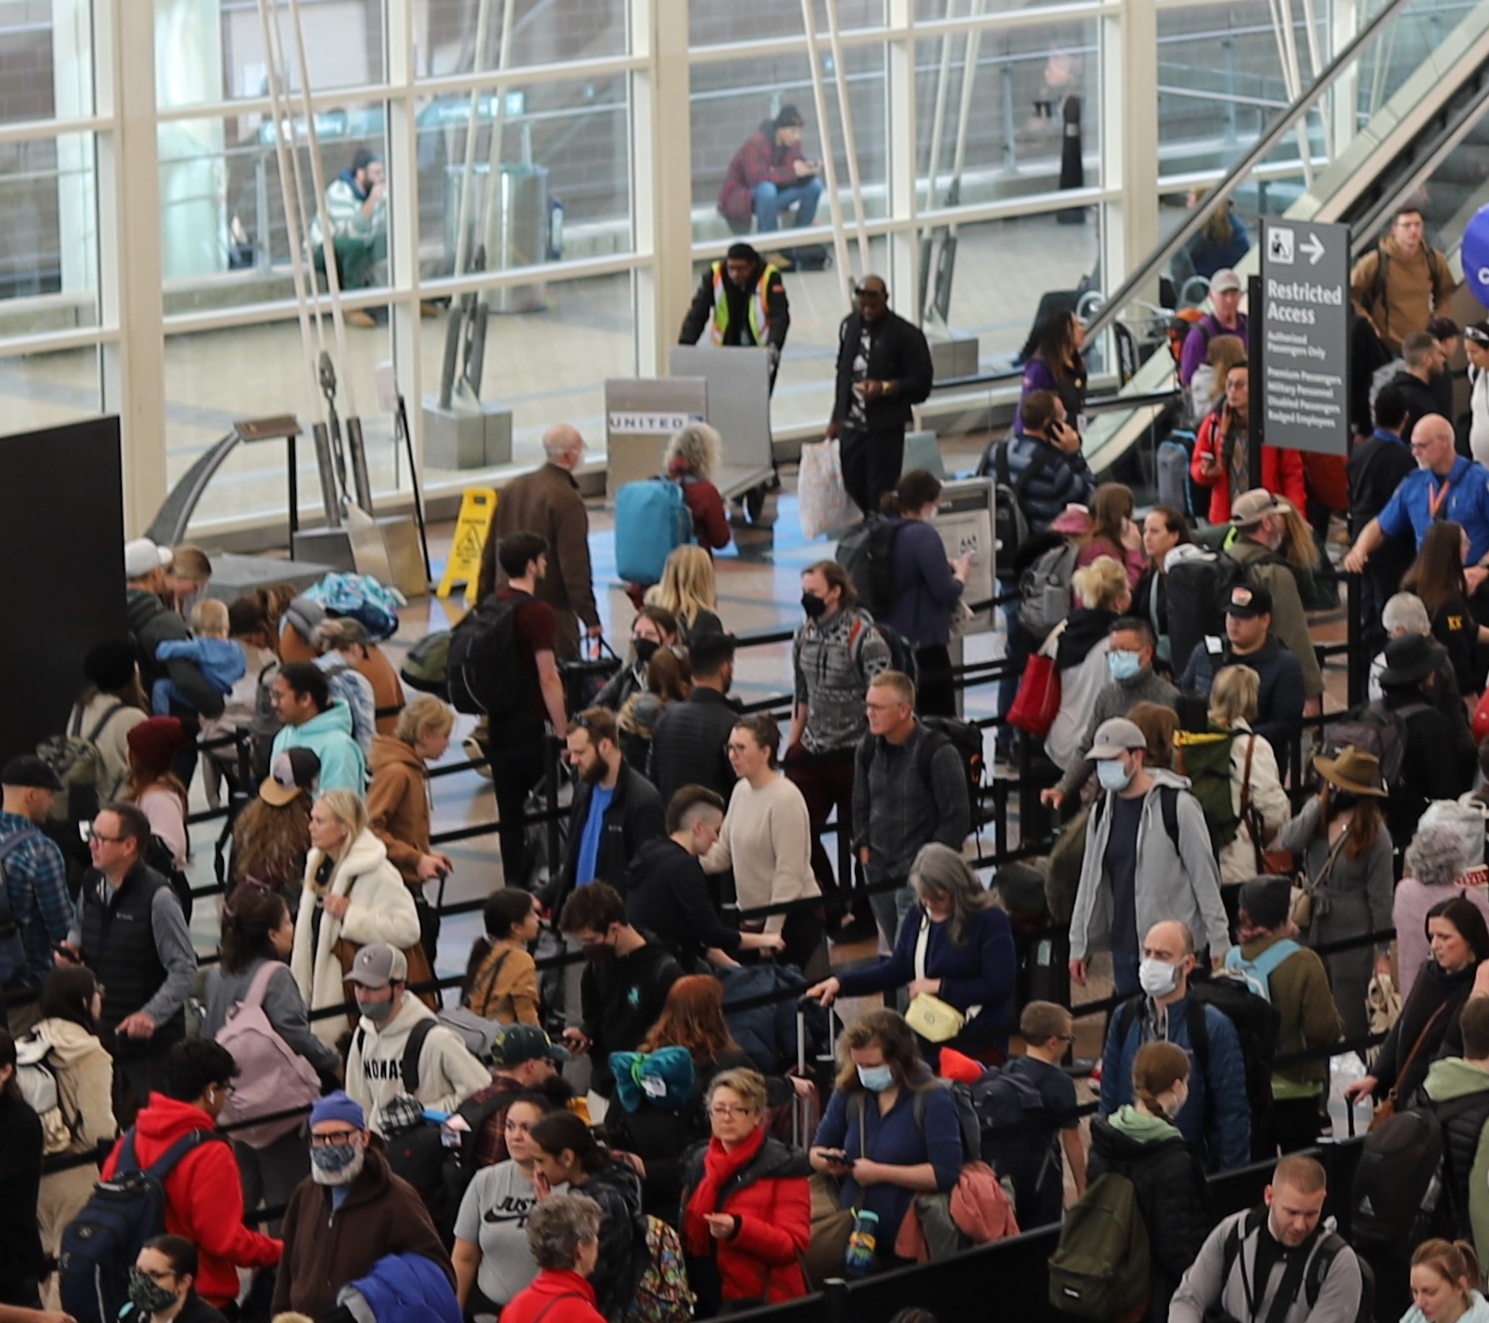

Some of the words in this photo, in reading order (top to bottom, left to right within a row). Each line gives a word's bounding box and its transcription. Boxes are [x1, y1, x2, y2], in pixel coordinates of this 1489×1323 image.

[1267, 278, 1342, 305] Restricted
[1267, 301, 1316, 325] Access
[1267, 331, 1308, 345] Authorized
[1267, 343, 1307, 358] Passengers
[1308, 346, 1326, 361] Only
[1267, 366, 1300, 380] Premium
[1301, 370, 1342, 387] Passengers
[1267, 381, 1296, 396] Military
[1297, 384, 1334, 398] Personnel
[1267, 395, 1299, 409] Disabled
[1300, 399, 1341, 415] Passengers
[609, 417, 684, 430] UNITED
